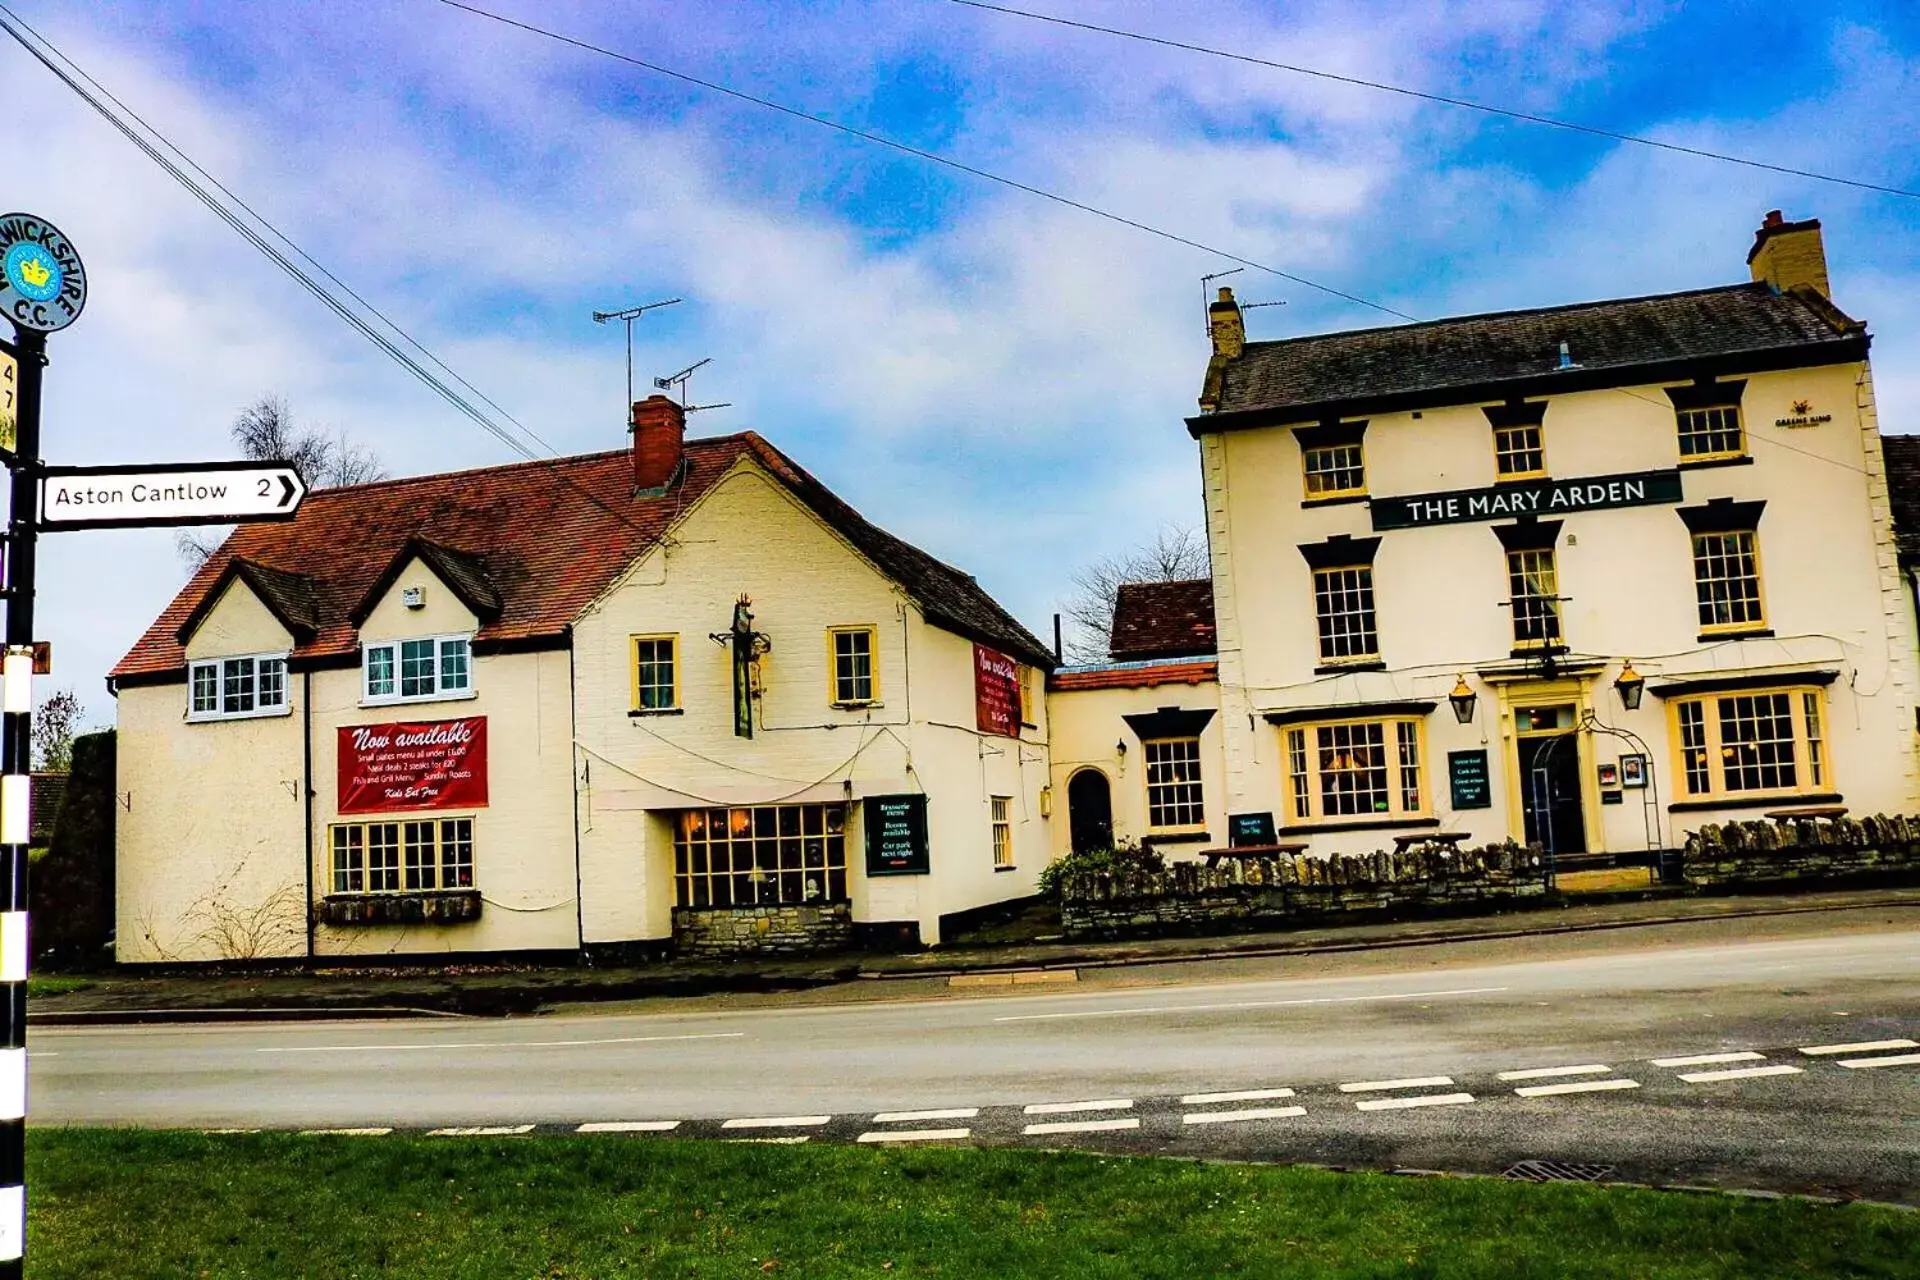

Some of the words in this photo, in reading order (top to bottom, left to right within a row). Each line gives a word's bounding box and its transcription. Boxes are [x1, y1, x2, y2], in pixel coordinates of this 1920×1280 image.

[55, 487, 123, 505] Aston
[131, 482, 228, 503] Cantlow
[256, 478, 271, 497] 2
[1407, 498, 1460, 521] THE
[1468, 490, 1541, 516] MARY
[1549, 480, 1646, 508] ARDEN
[352, 727, 390, 751] Now
[396, 722, 471, 747] available
[396, 751, 415, 760] menu
[425, 748, 445, 758] under
[403, 762, 408, 771] 2
[384, 788, 402, 798] Kids
[404, 786, 419, 798] Eat
[420, 786, 439, 798] Free
